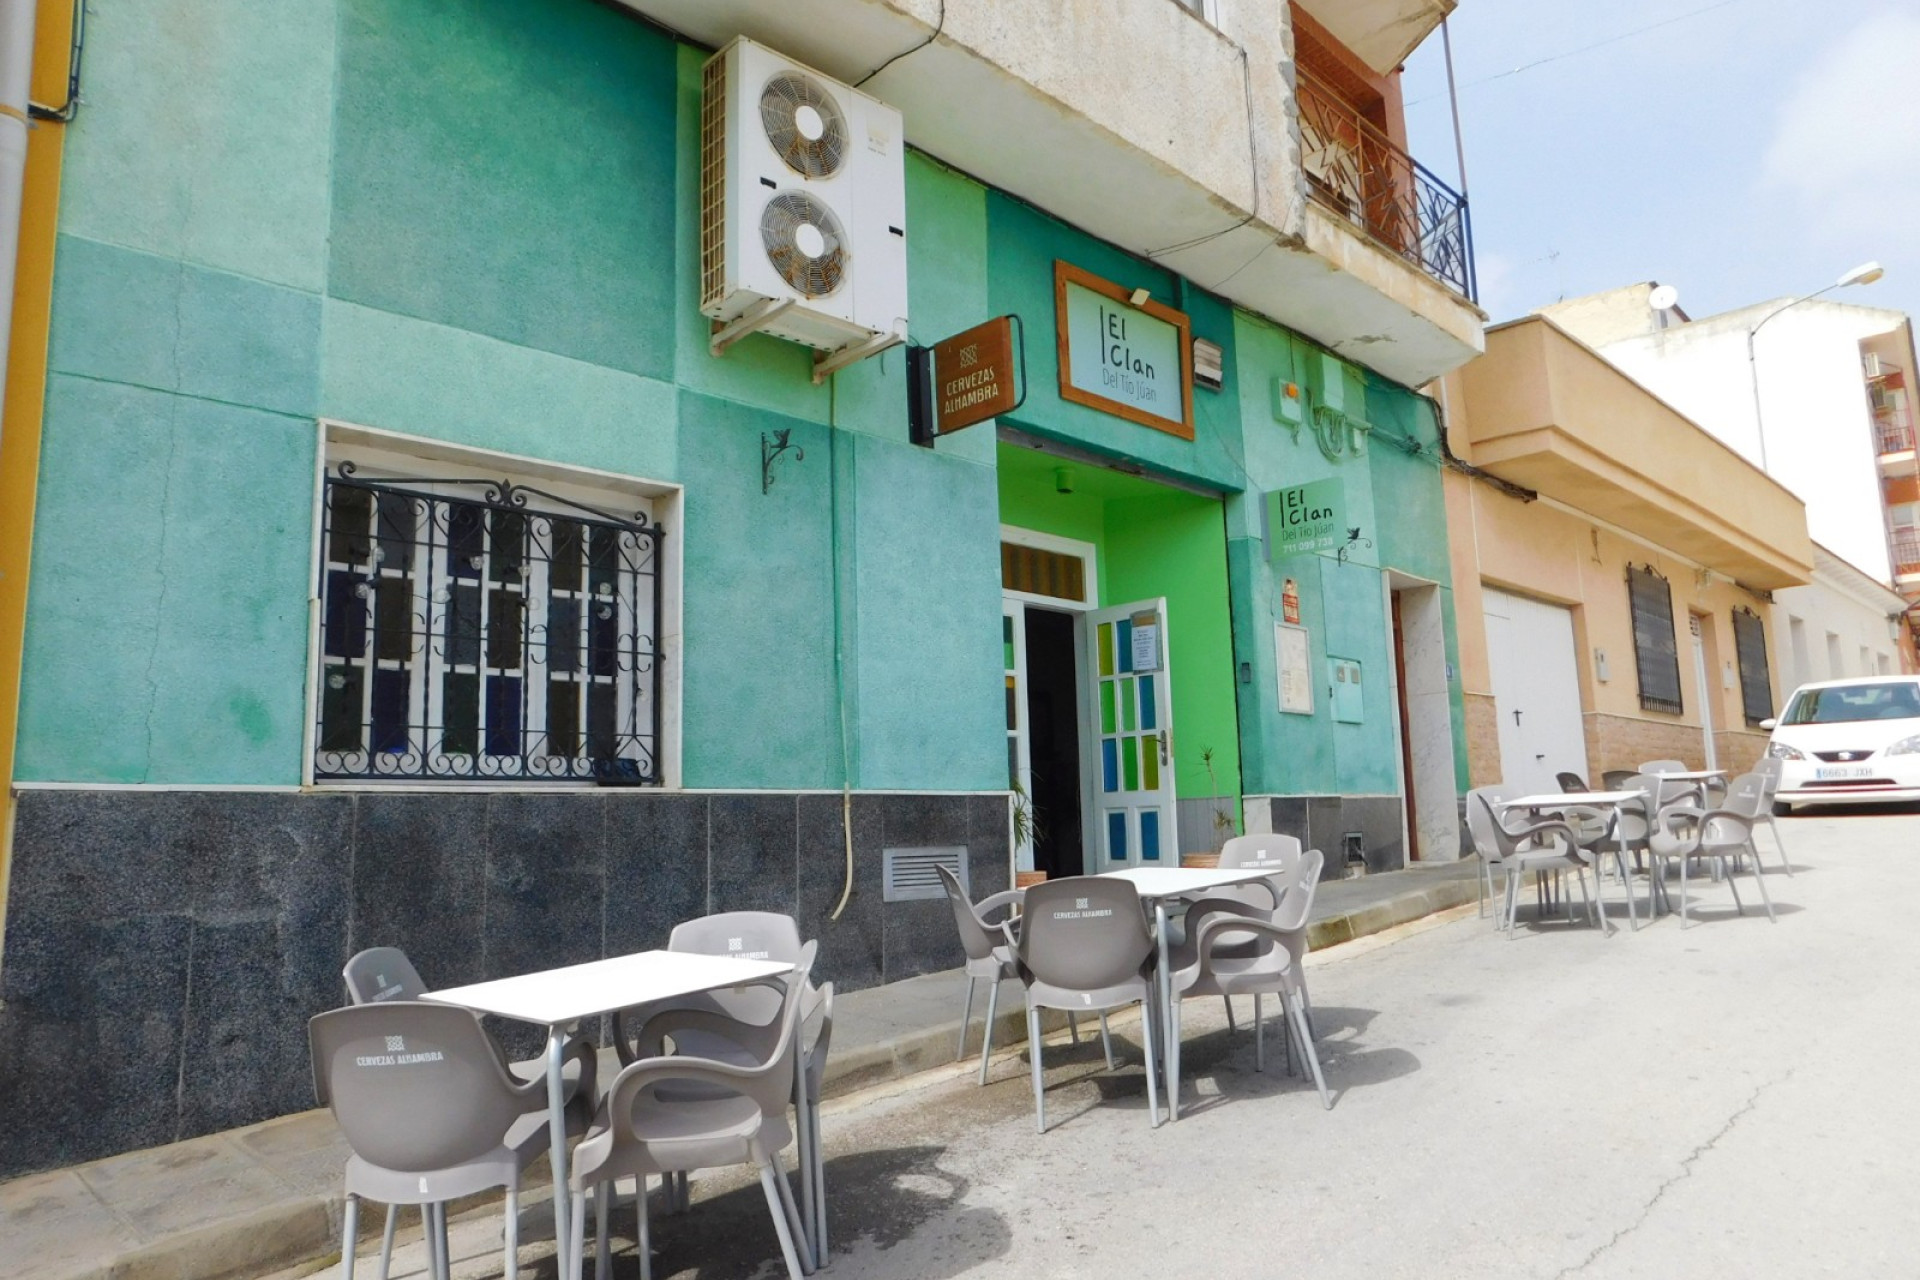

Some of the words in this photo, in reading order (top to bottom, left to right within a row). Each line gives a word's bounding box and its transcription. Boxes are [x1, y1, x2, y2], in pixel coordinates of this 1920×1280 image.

[1108, 313, 1126, 341] El
[1110, 344, 1155, 380] Clan
[946, 365, 995, 396] CERVEZAS
[1103, 368, 1118, 389] Del
[944, 382, 999, 415] ALHAMBRA
[1287, 489, 1304, 507] El
[1289, 507, 1333, 525] Clan
[1282, 528, 1297, 541] Del
[356, 1055, 396, 1066] CERVEZAS
[397, 1051, 444, 1064] ALHAMBRA
